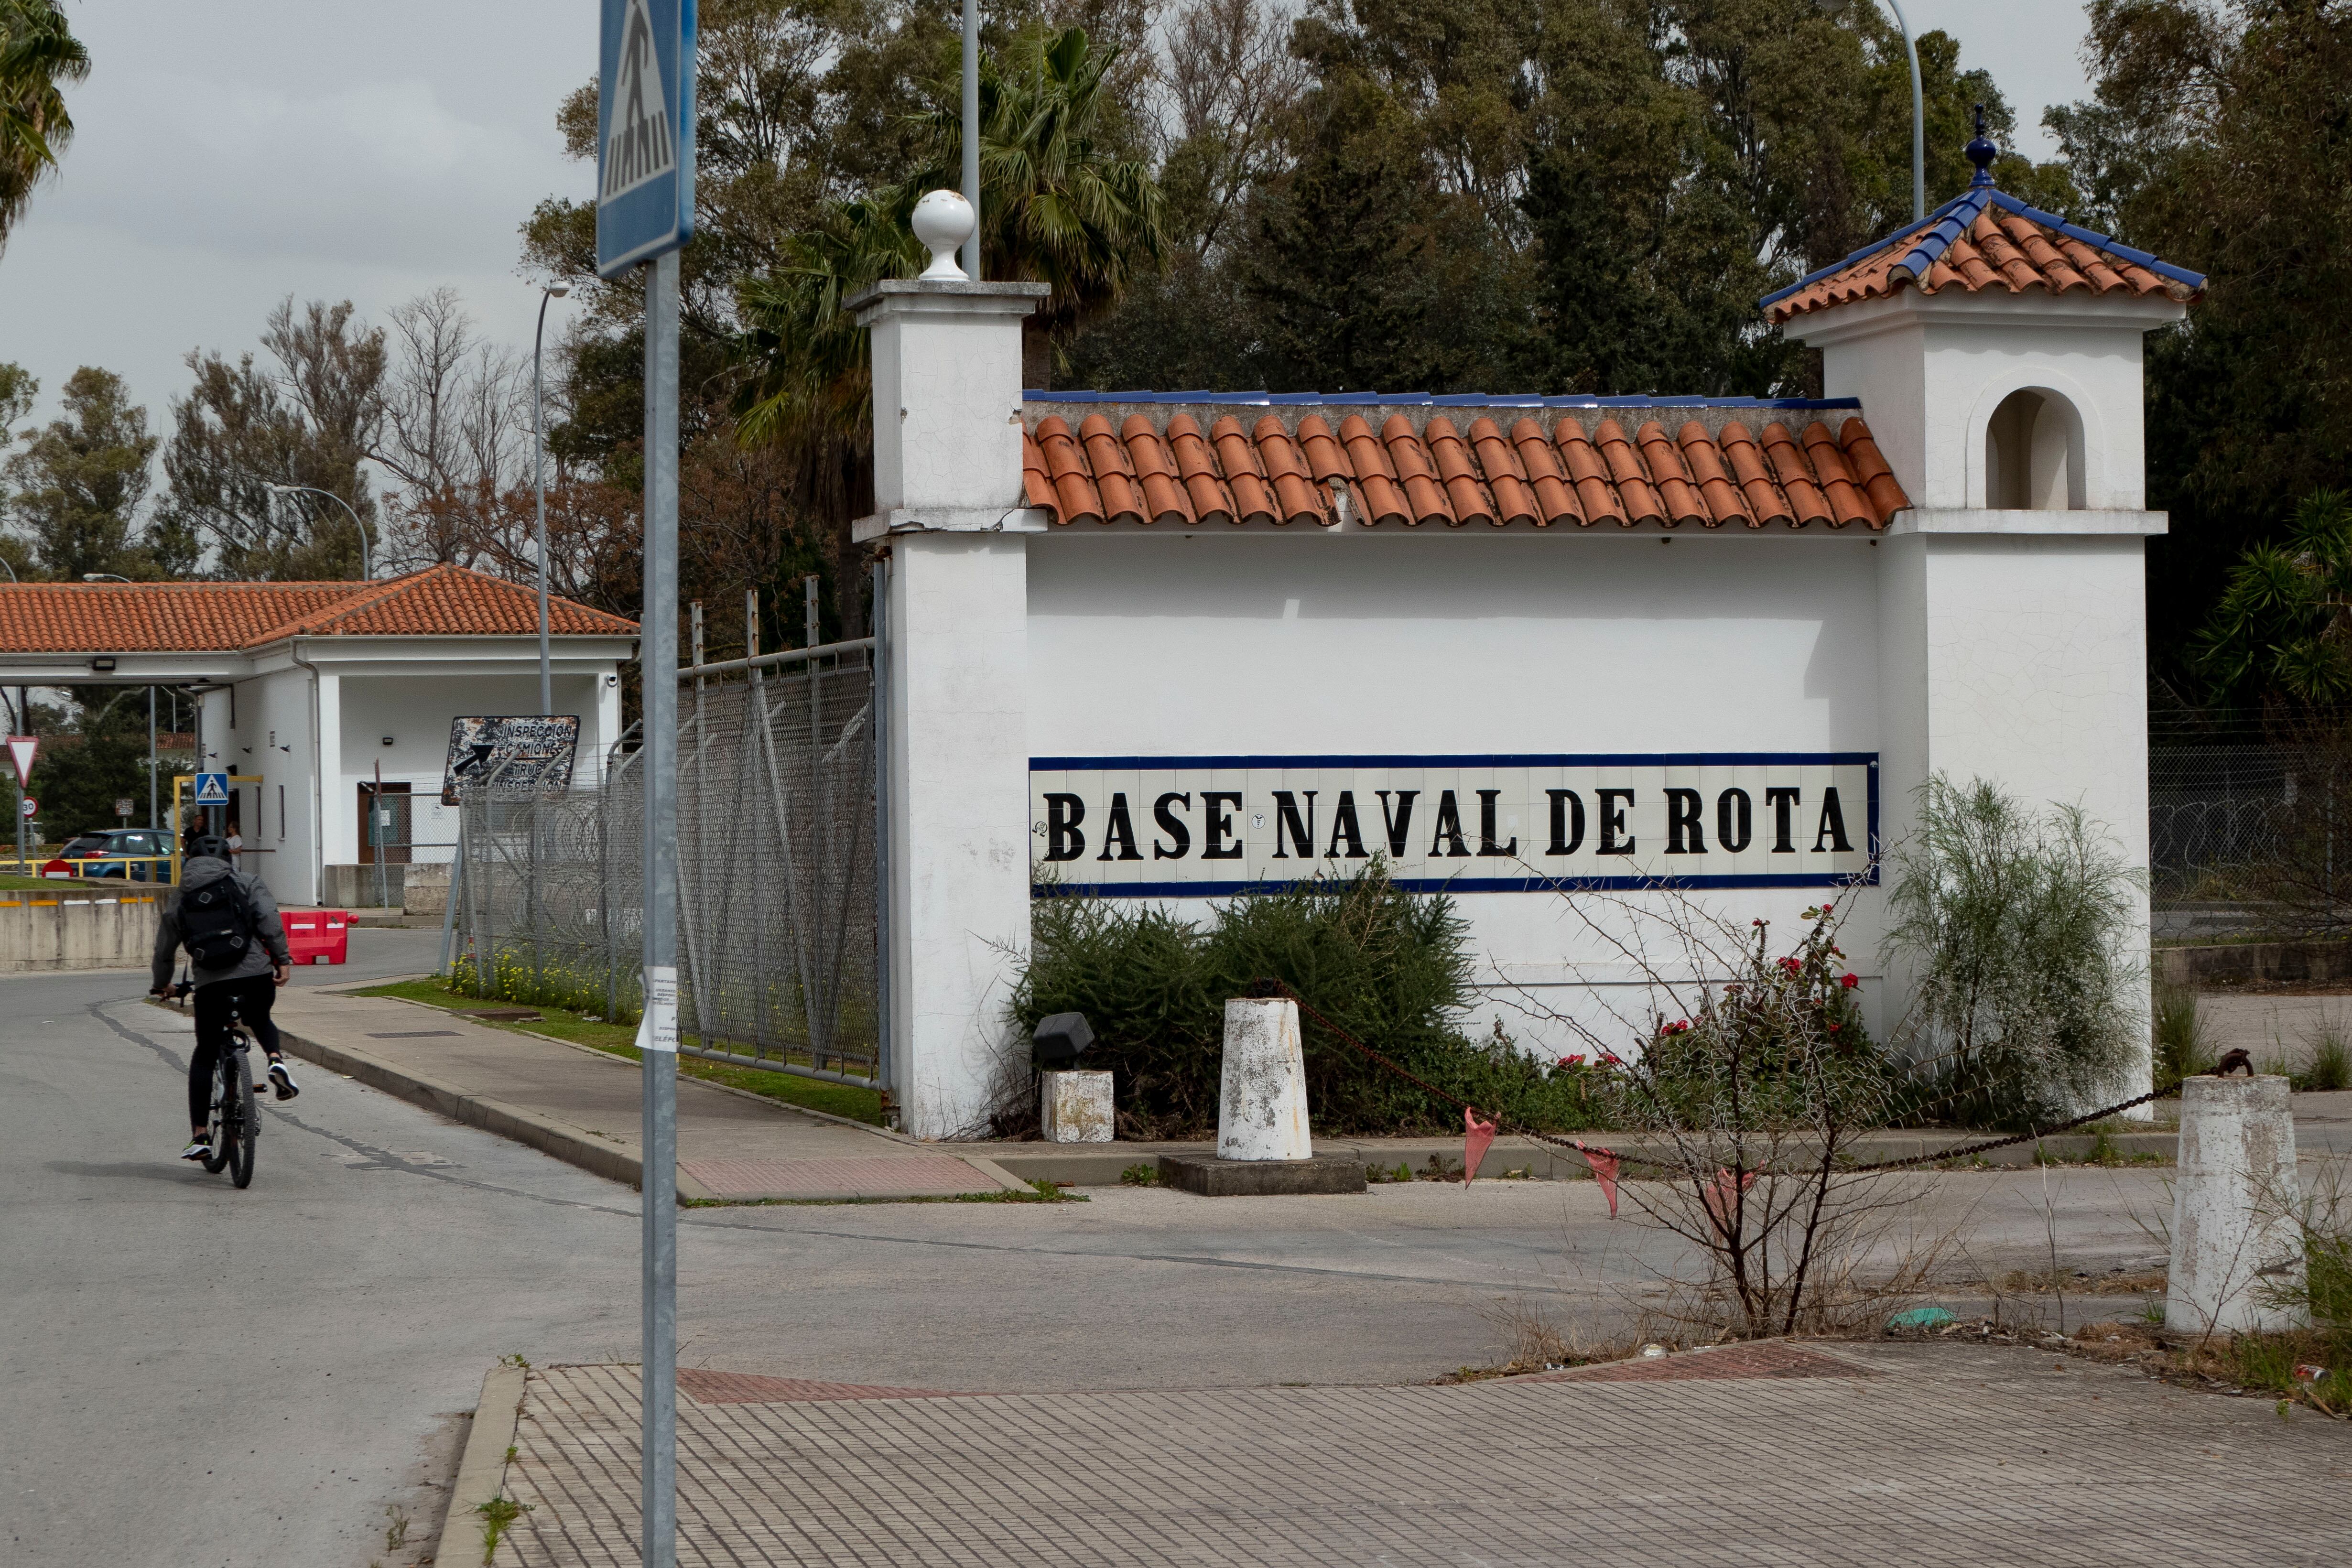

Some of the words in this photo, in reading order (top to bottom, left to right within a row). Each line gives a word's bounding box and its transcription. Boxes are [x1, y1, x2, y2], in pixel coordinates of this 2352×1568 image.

[504, 725, 572, 737] INSPECCION
[514, 764, 542, 776] TRUC
[496, 780, 563, 792] INSPECION
[1042, 791, 1243, 861] BASE
[1271, 789, 1517, 859] NAVAL
[1545, 788, 1636, 856] DE
[1663, 787, 1854, 854] ROTA
